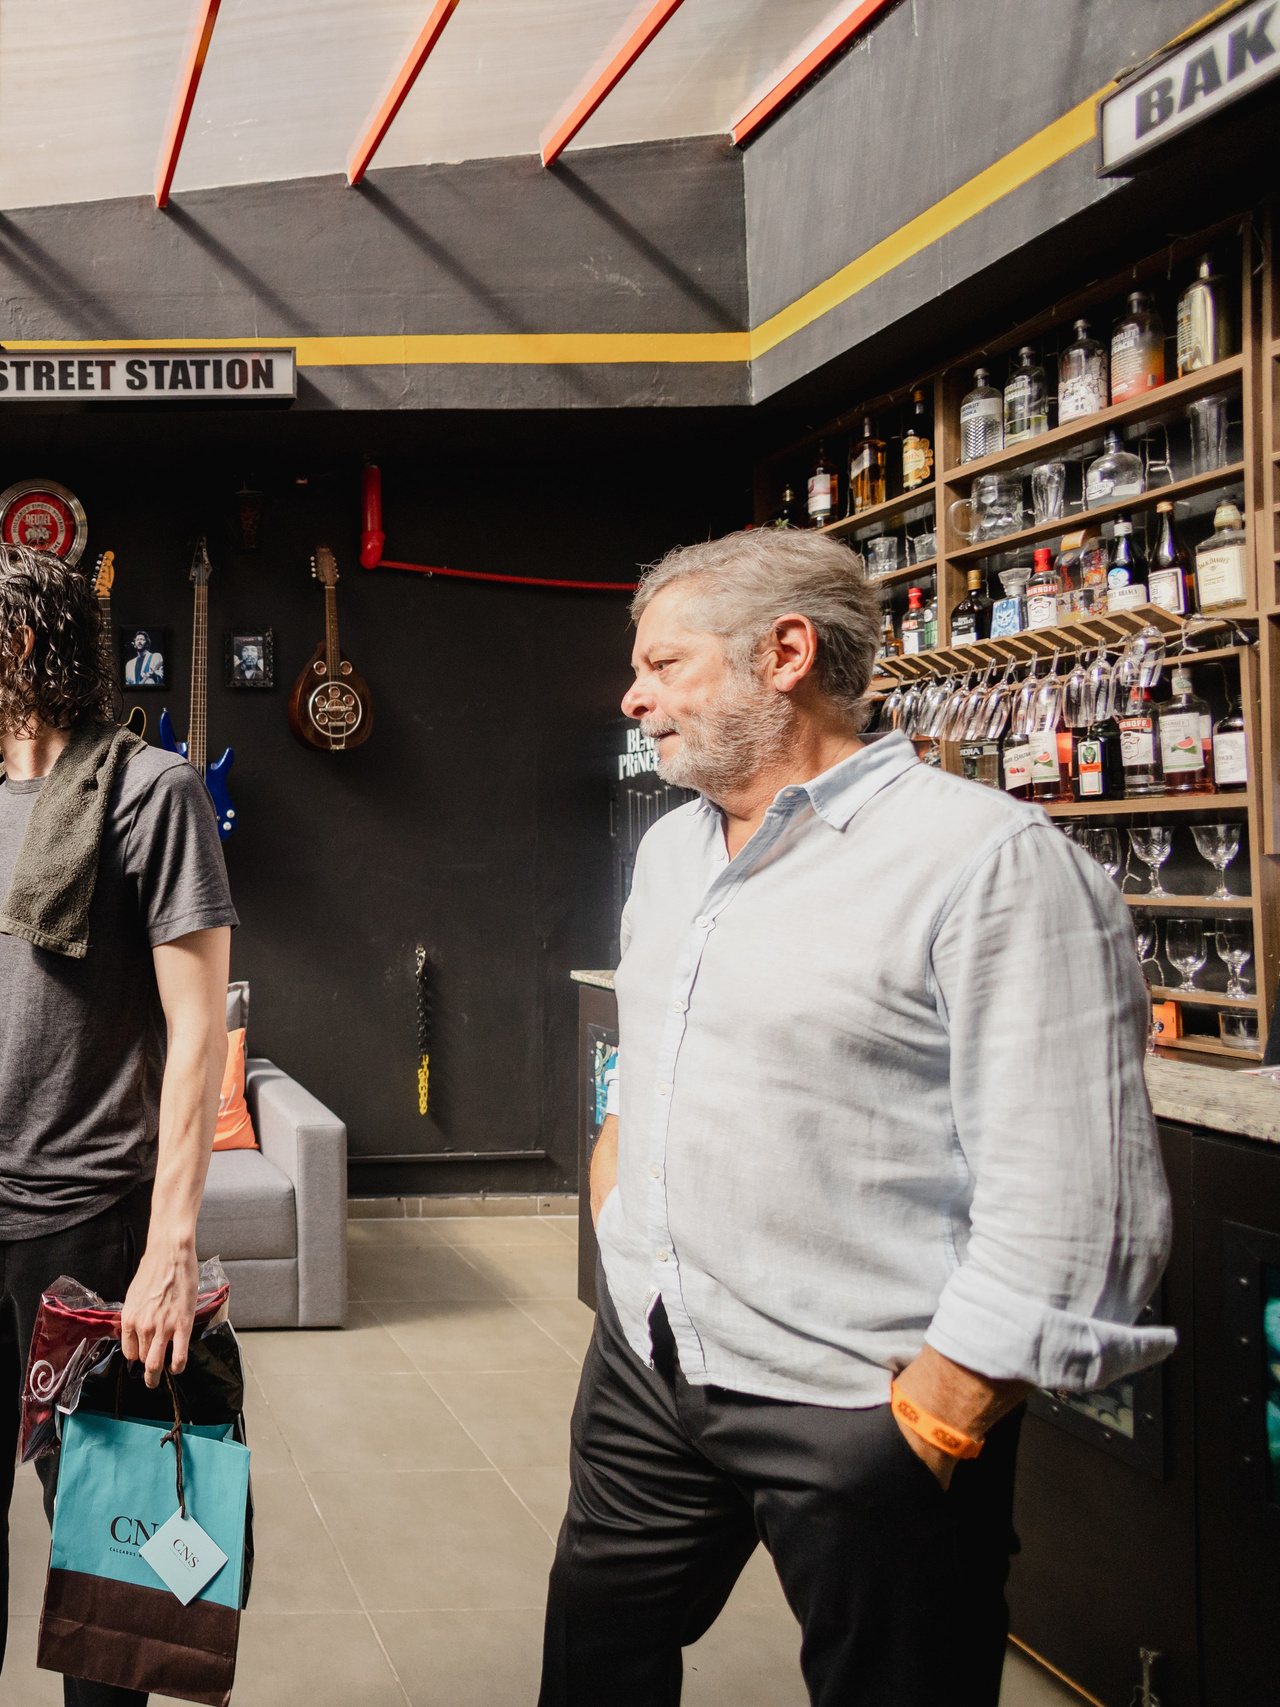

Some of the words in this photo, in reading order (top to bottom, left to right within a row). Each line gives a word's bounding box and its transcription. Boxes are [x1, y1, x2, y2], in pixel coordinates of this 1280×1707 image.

[124, 358, 275, 390] STATION
[109, 1546, 136, 1557] CALÇADOS
[172, 1538, 200, 1569] CNS
